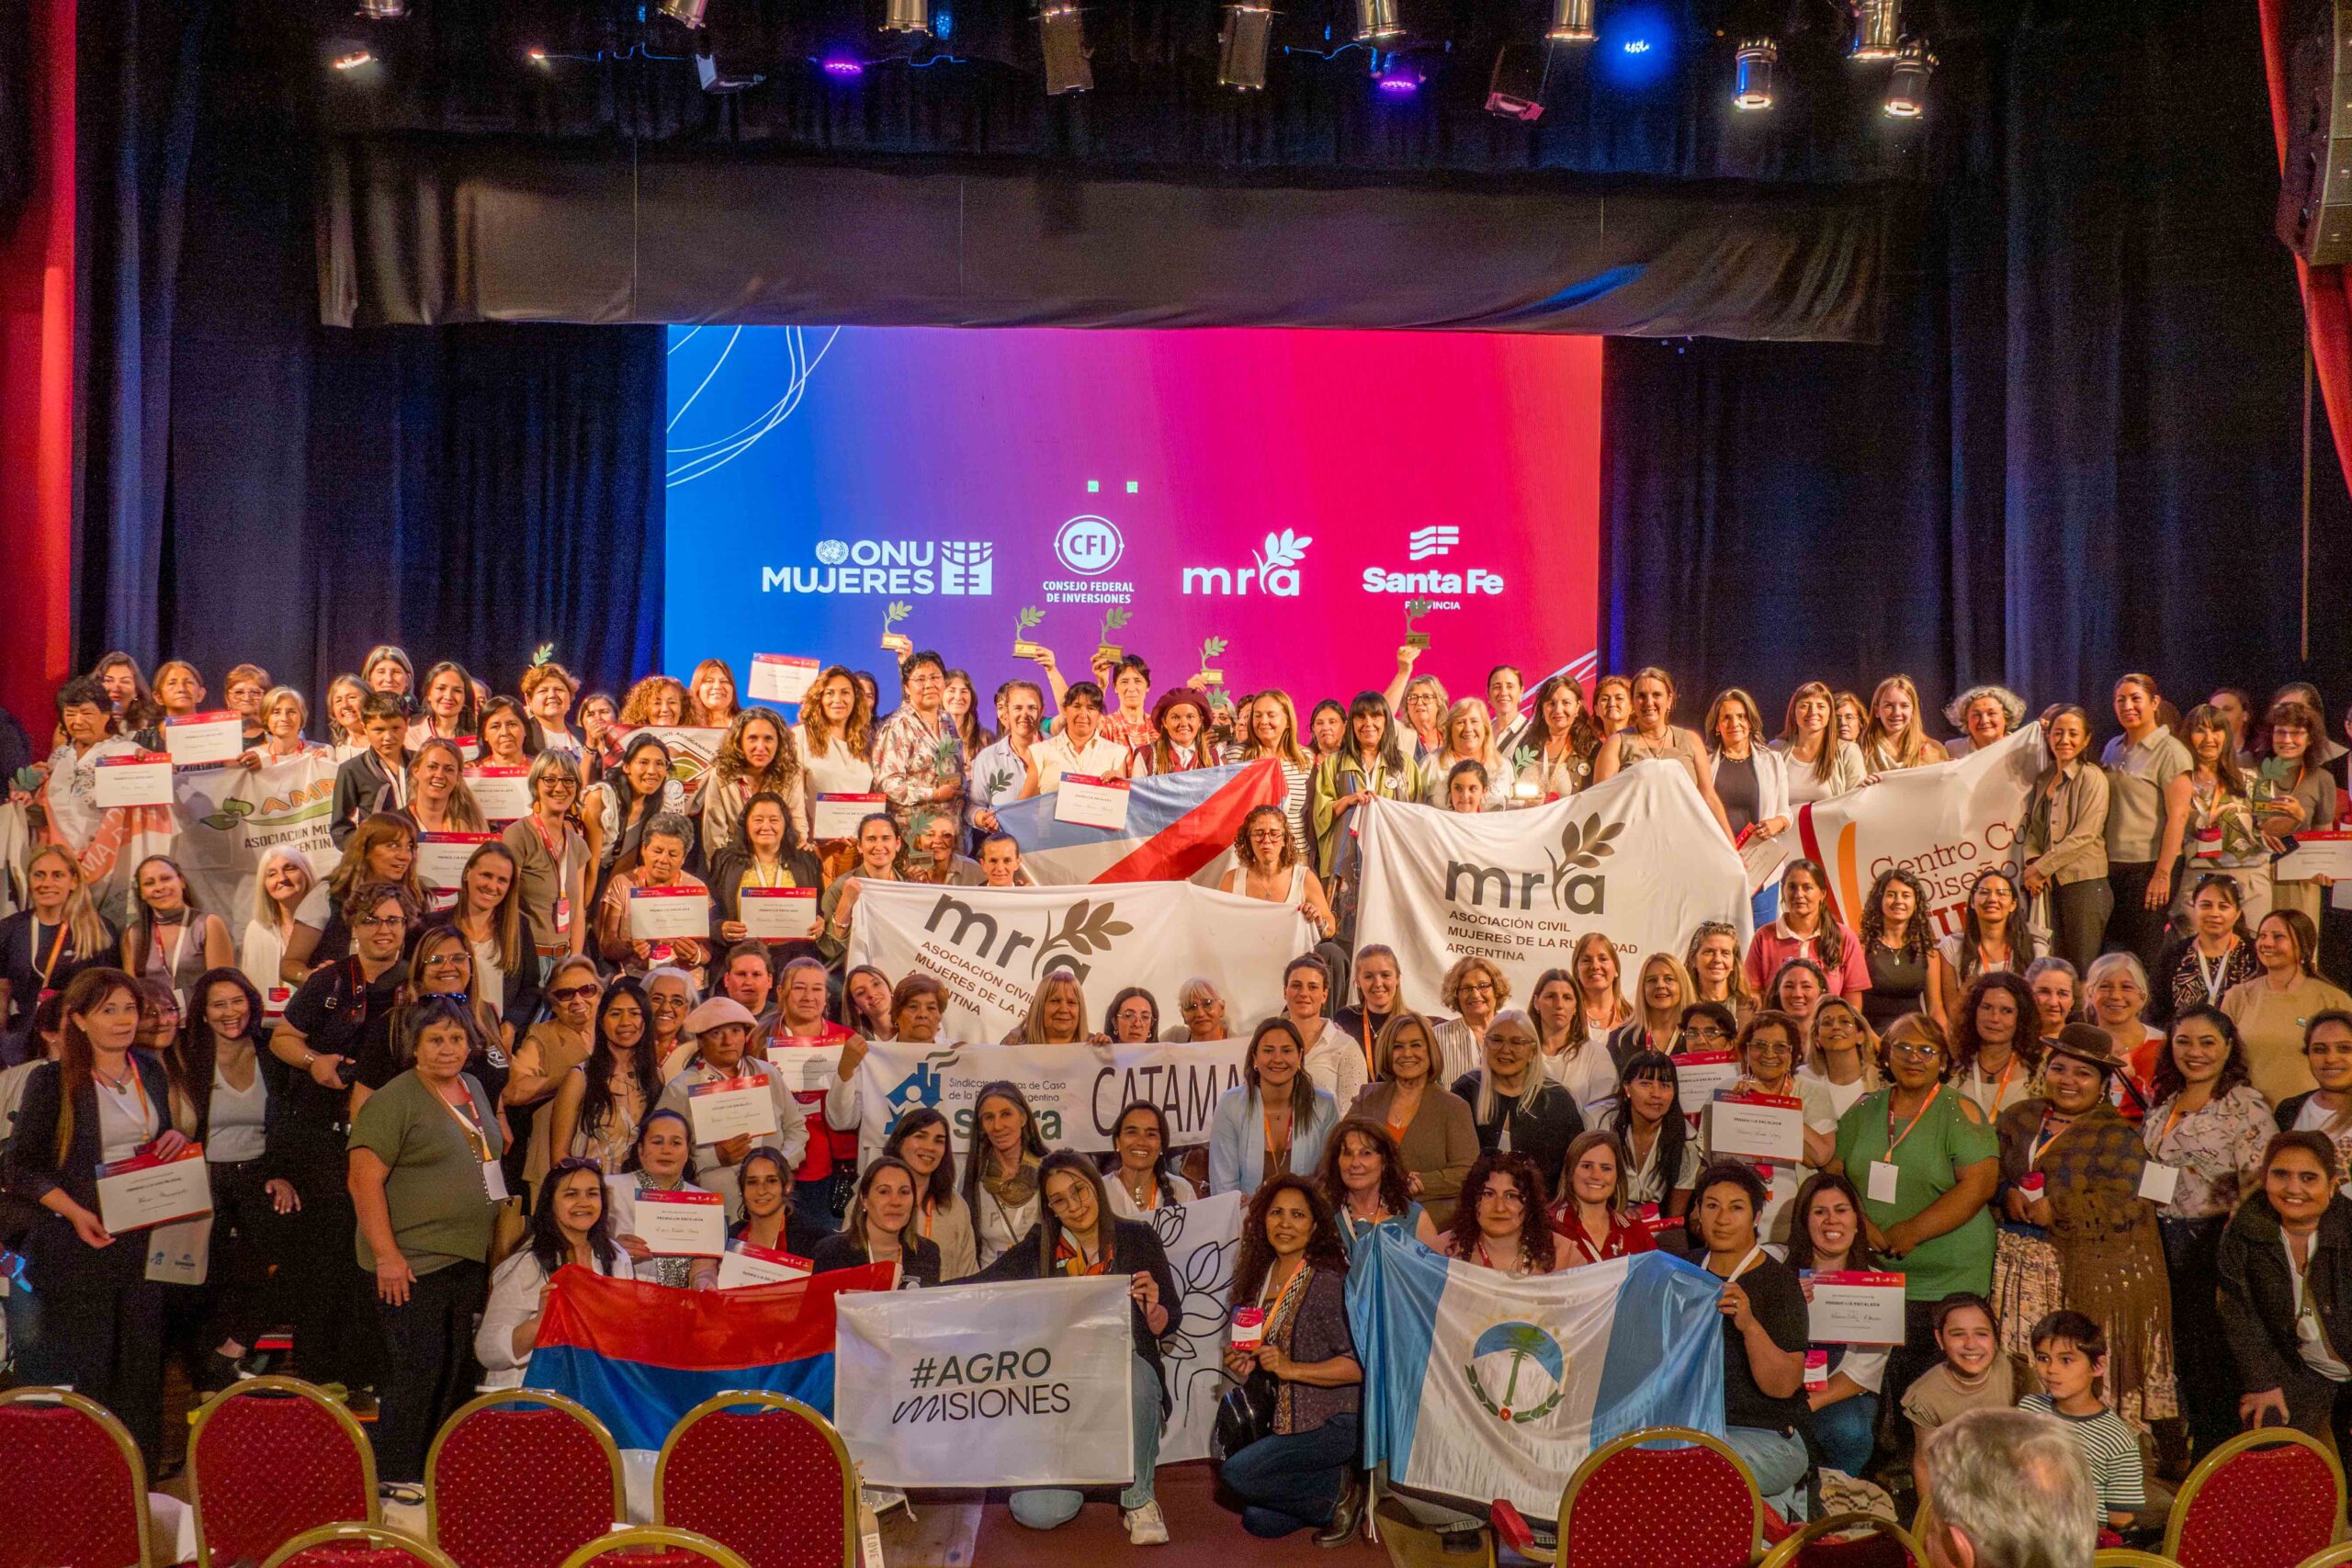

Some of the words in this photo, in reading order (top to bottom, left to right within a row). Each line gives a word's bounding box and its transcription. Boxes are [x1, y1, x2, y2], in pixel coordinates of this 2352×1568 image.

[852, 540, 933, 567] ONU
[1069, 535, 1107, 556] CFI
[762, 567, 934, 594] MUJERES
[1043, 581, 1088, 591] CONSEJO
[1091, 582, 1135, 592] FEDERAL
[1362, 567, 1463, 593] Santa
[1466, 569, 1504, 595] Fe
[1046, 593, 1060, 603] DE
[1062, 593, 1131, 604] INVERSIONES
[1445, 860, 1605, 915] mra
[1449, 910, 1533, 930] ASOCIACIÓN
[1538, 921, 1571, 932] CIVIL
[1447, 926, 1512, 944] MUJERES
[1516, 936, 1534, 946] DE
[1538, 938, 1555, 948] LA
[1446, 942, 1525, 962] ARGENTINA
[915, 953, 976, 992] MUJERES
[978, 987, 998, 1005] DE
[999, 998, 1015, 1017] LA
[922, 941, 1003, 987] ASOCIACIÓN
[1005, 983, 1034, 1005] CIVIL
[949, 1077, 989, 1088] Sindicat
[1043, 1081, 1066, 1089] Casa
[949, 1091, 961, 1100] de
[964, 1090, 972, 1100] la
[910, 1347, 1052, 1389] #AGRO
[892, 1382, 1070, 1425] MISIONES
